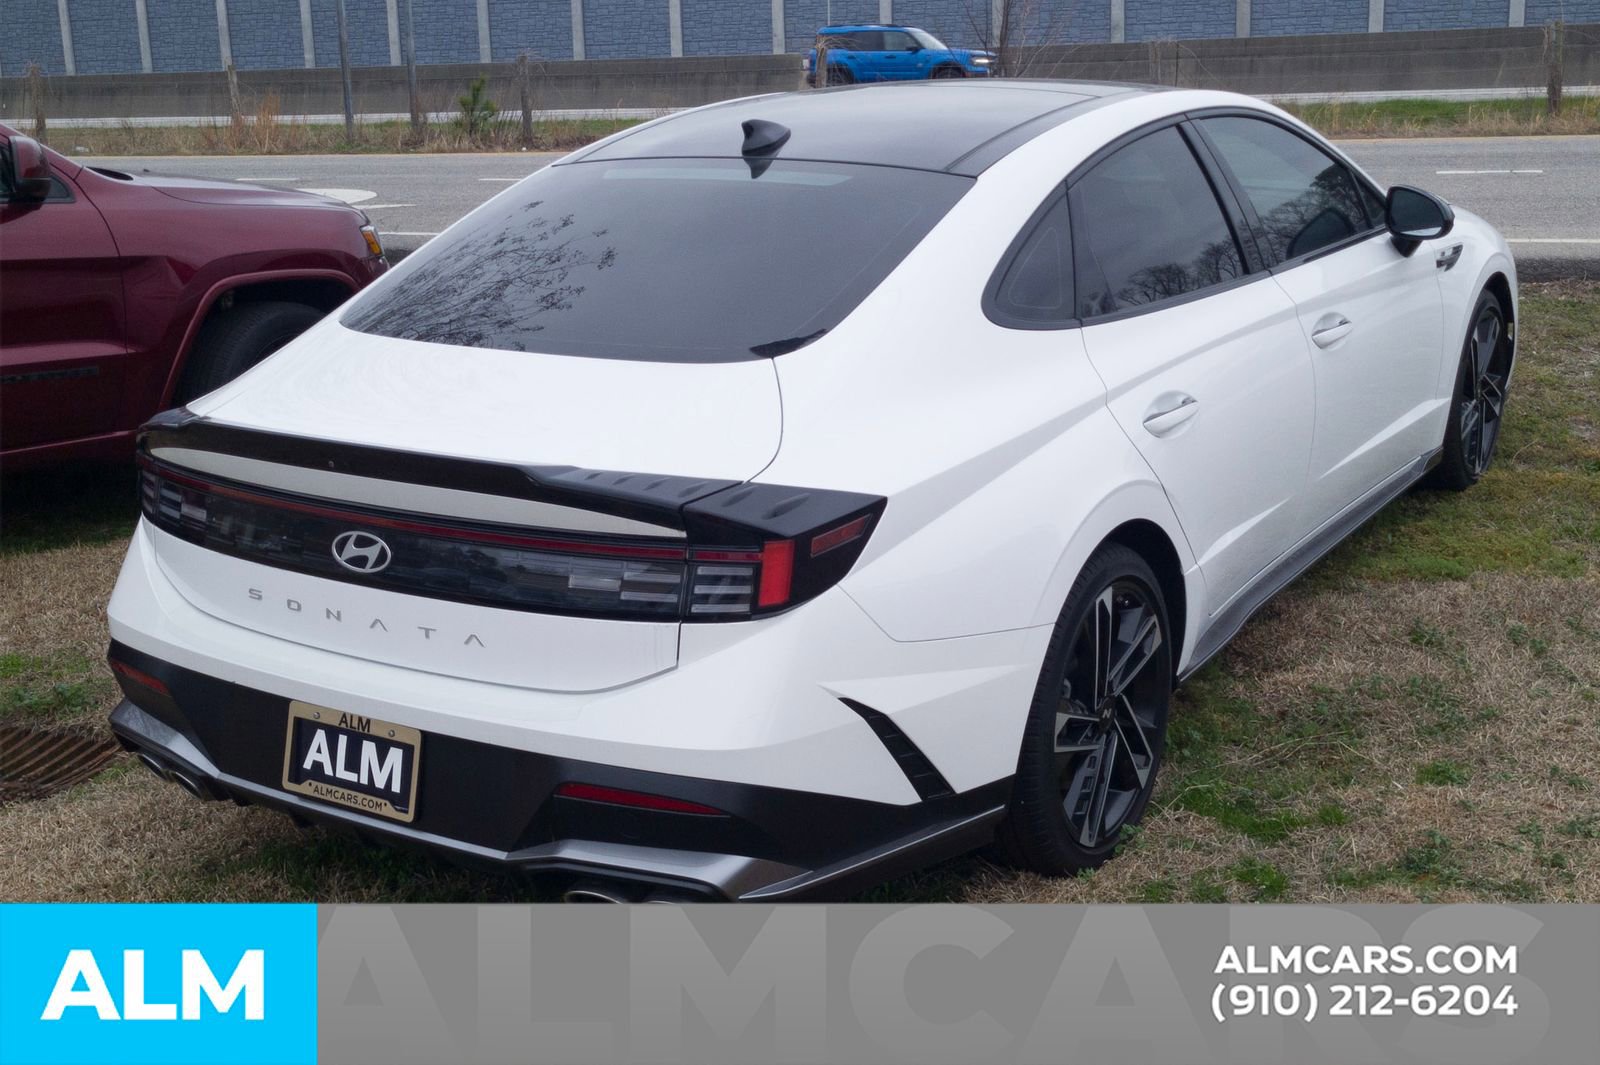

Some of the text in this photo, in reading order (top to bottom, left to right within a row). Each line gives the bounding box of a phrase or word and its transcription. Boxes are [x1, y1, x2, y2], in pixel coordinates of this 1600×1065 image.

[248, 588, 486, 648] SONATA
[338, 712, 371, 733] ALM
[302, 728, 403, 793] ALM
[313, 784, 383, 812] ALMCARS.COM
